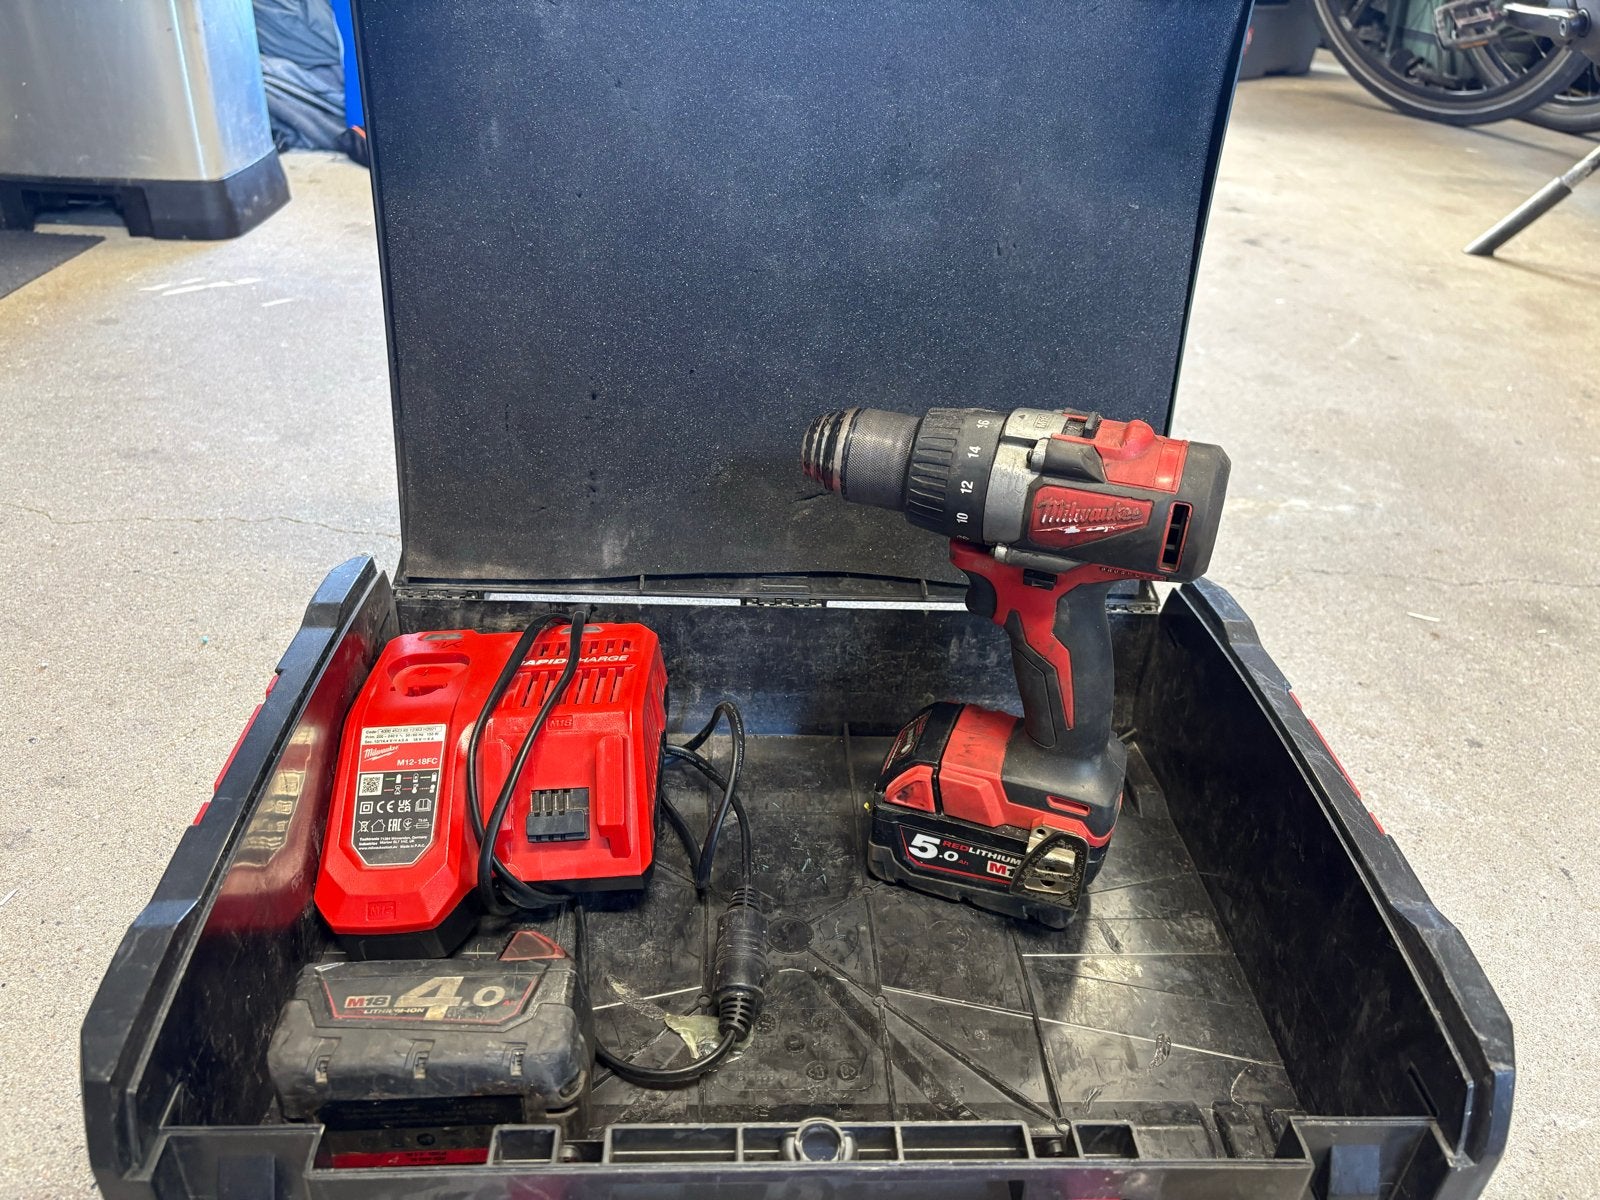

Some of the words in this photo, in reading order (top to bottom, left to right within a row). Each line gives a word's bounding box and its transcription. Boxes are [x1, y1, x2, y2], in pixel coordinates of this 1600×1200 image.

[976, 419, 990, 428] 16
[967, 445, 981, 458] 14
[960, 480, 974, 494] 12
[956, 512, 969, 523] 10
[1036, 498, 1143, 525] Milwaukee
[579, 654, 630, 663] HARGE
[363, 745, 400, 759] Milwaukee
[397, 758, 438, 766] M12-18FC
[376, 800, 395, 813] CE
[908, 834, 959, 862] 5.0
[942, 840, 1023, 866] REDLITHIUM
[989, 862, 1015, 877] M1
[347, 996, 387, 1008] M18
[394, 976, 506, 1021] 4.0
